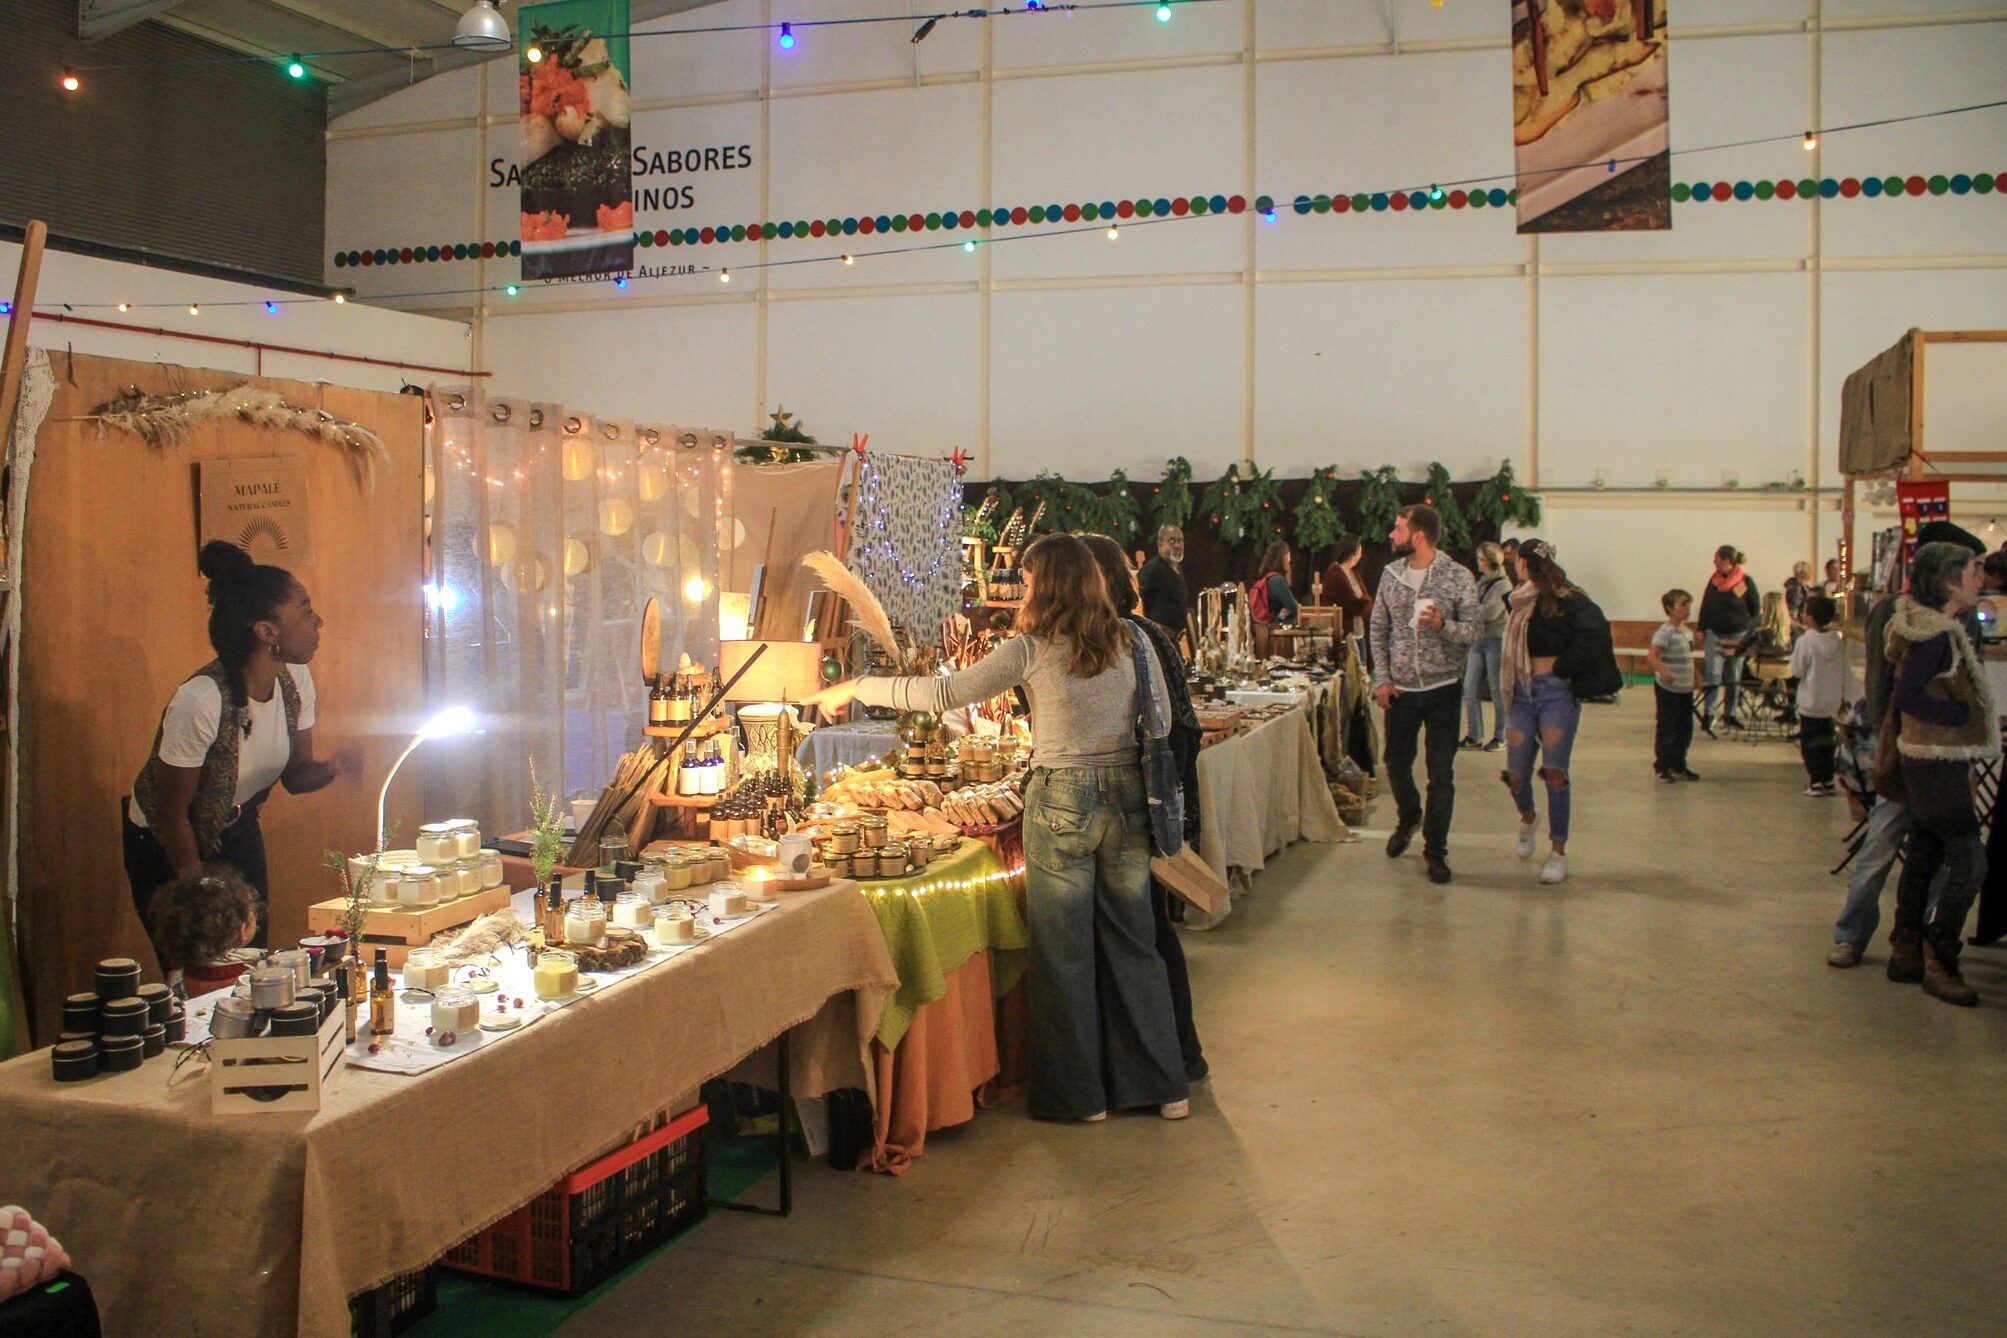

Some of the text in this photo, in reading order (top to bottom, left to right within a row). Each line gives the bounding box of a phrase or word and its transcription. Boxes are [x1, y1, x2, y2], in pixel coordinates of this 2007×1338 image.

[490, 145, 752, 187] SA SABORES
[634, 186, 694, 212] INOS
[639, 264, 695, 278] ALJEZUR
